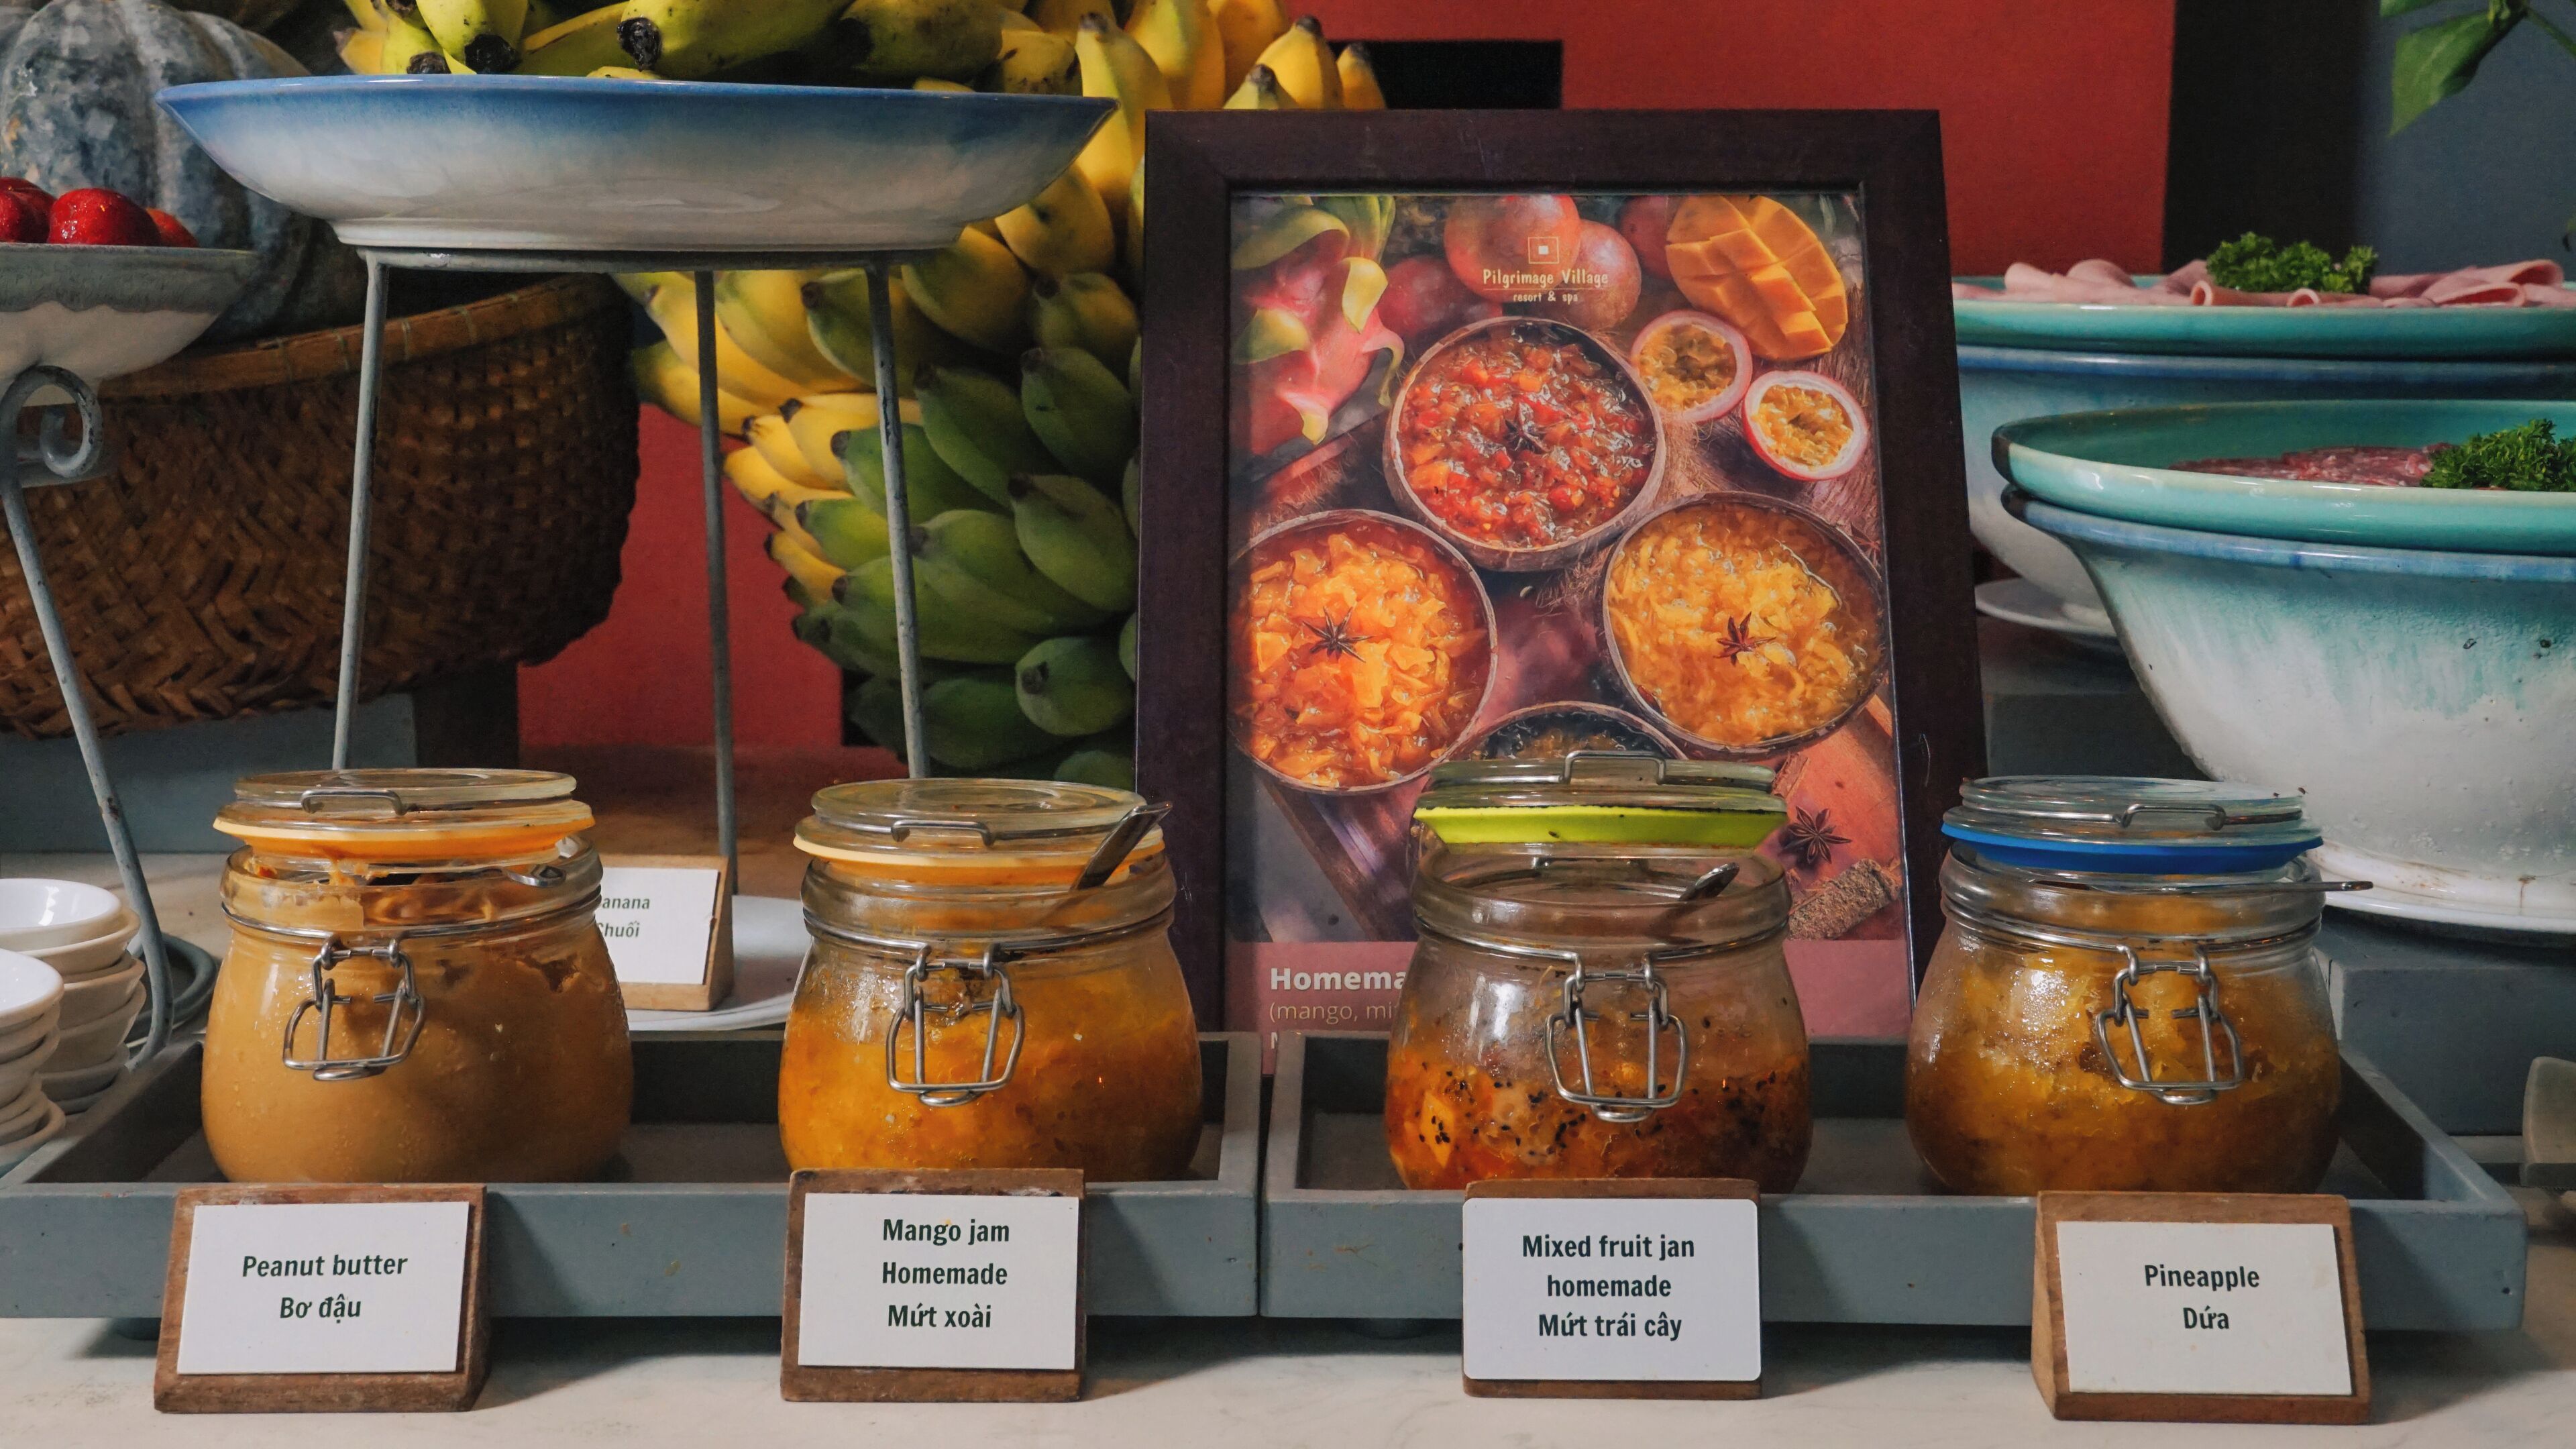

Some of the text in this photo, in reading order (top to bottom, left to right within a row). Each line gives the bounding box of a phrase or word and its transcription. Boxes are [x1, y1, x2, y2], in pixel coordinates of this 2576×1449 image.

[1483, 268, 1609, 289] Pilgrimage Village
[1513, 290, 1578, 305] resort & spa
[602, 897, 650, 910] anana
[597, 920, 640, 938] huối
[1269, 1002, 1358, 1025] (mango,
[882, 1218, 1010, 1246] Mango jam
[1521, 1234, 1695, 1261] Mixed fruit jan
[241, 1254, 409, 1277] Peanut butter
[881, 1261, 1008, 1286] Homemade
[2144, 1263, 2261, 1292] Pineapple
[1547, 1275, 1672, 1297] homemade
[279, 1293, 362, 1324] Bơ đậu
[888, 1302, 992, 1328] Mứt xoài
[2182, 1305, 2231, 1330] Dứa
[1538, 1311, 1682, 1342] Mứt trái cây
